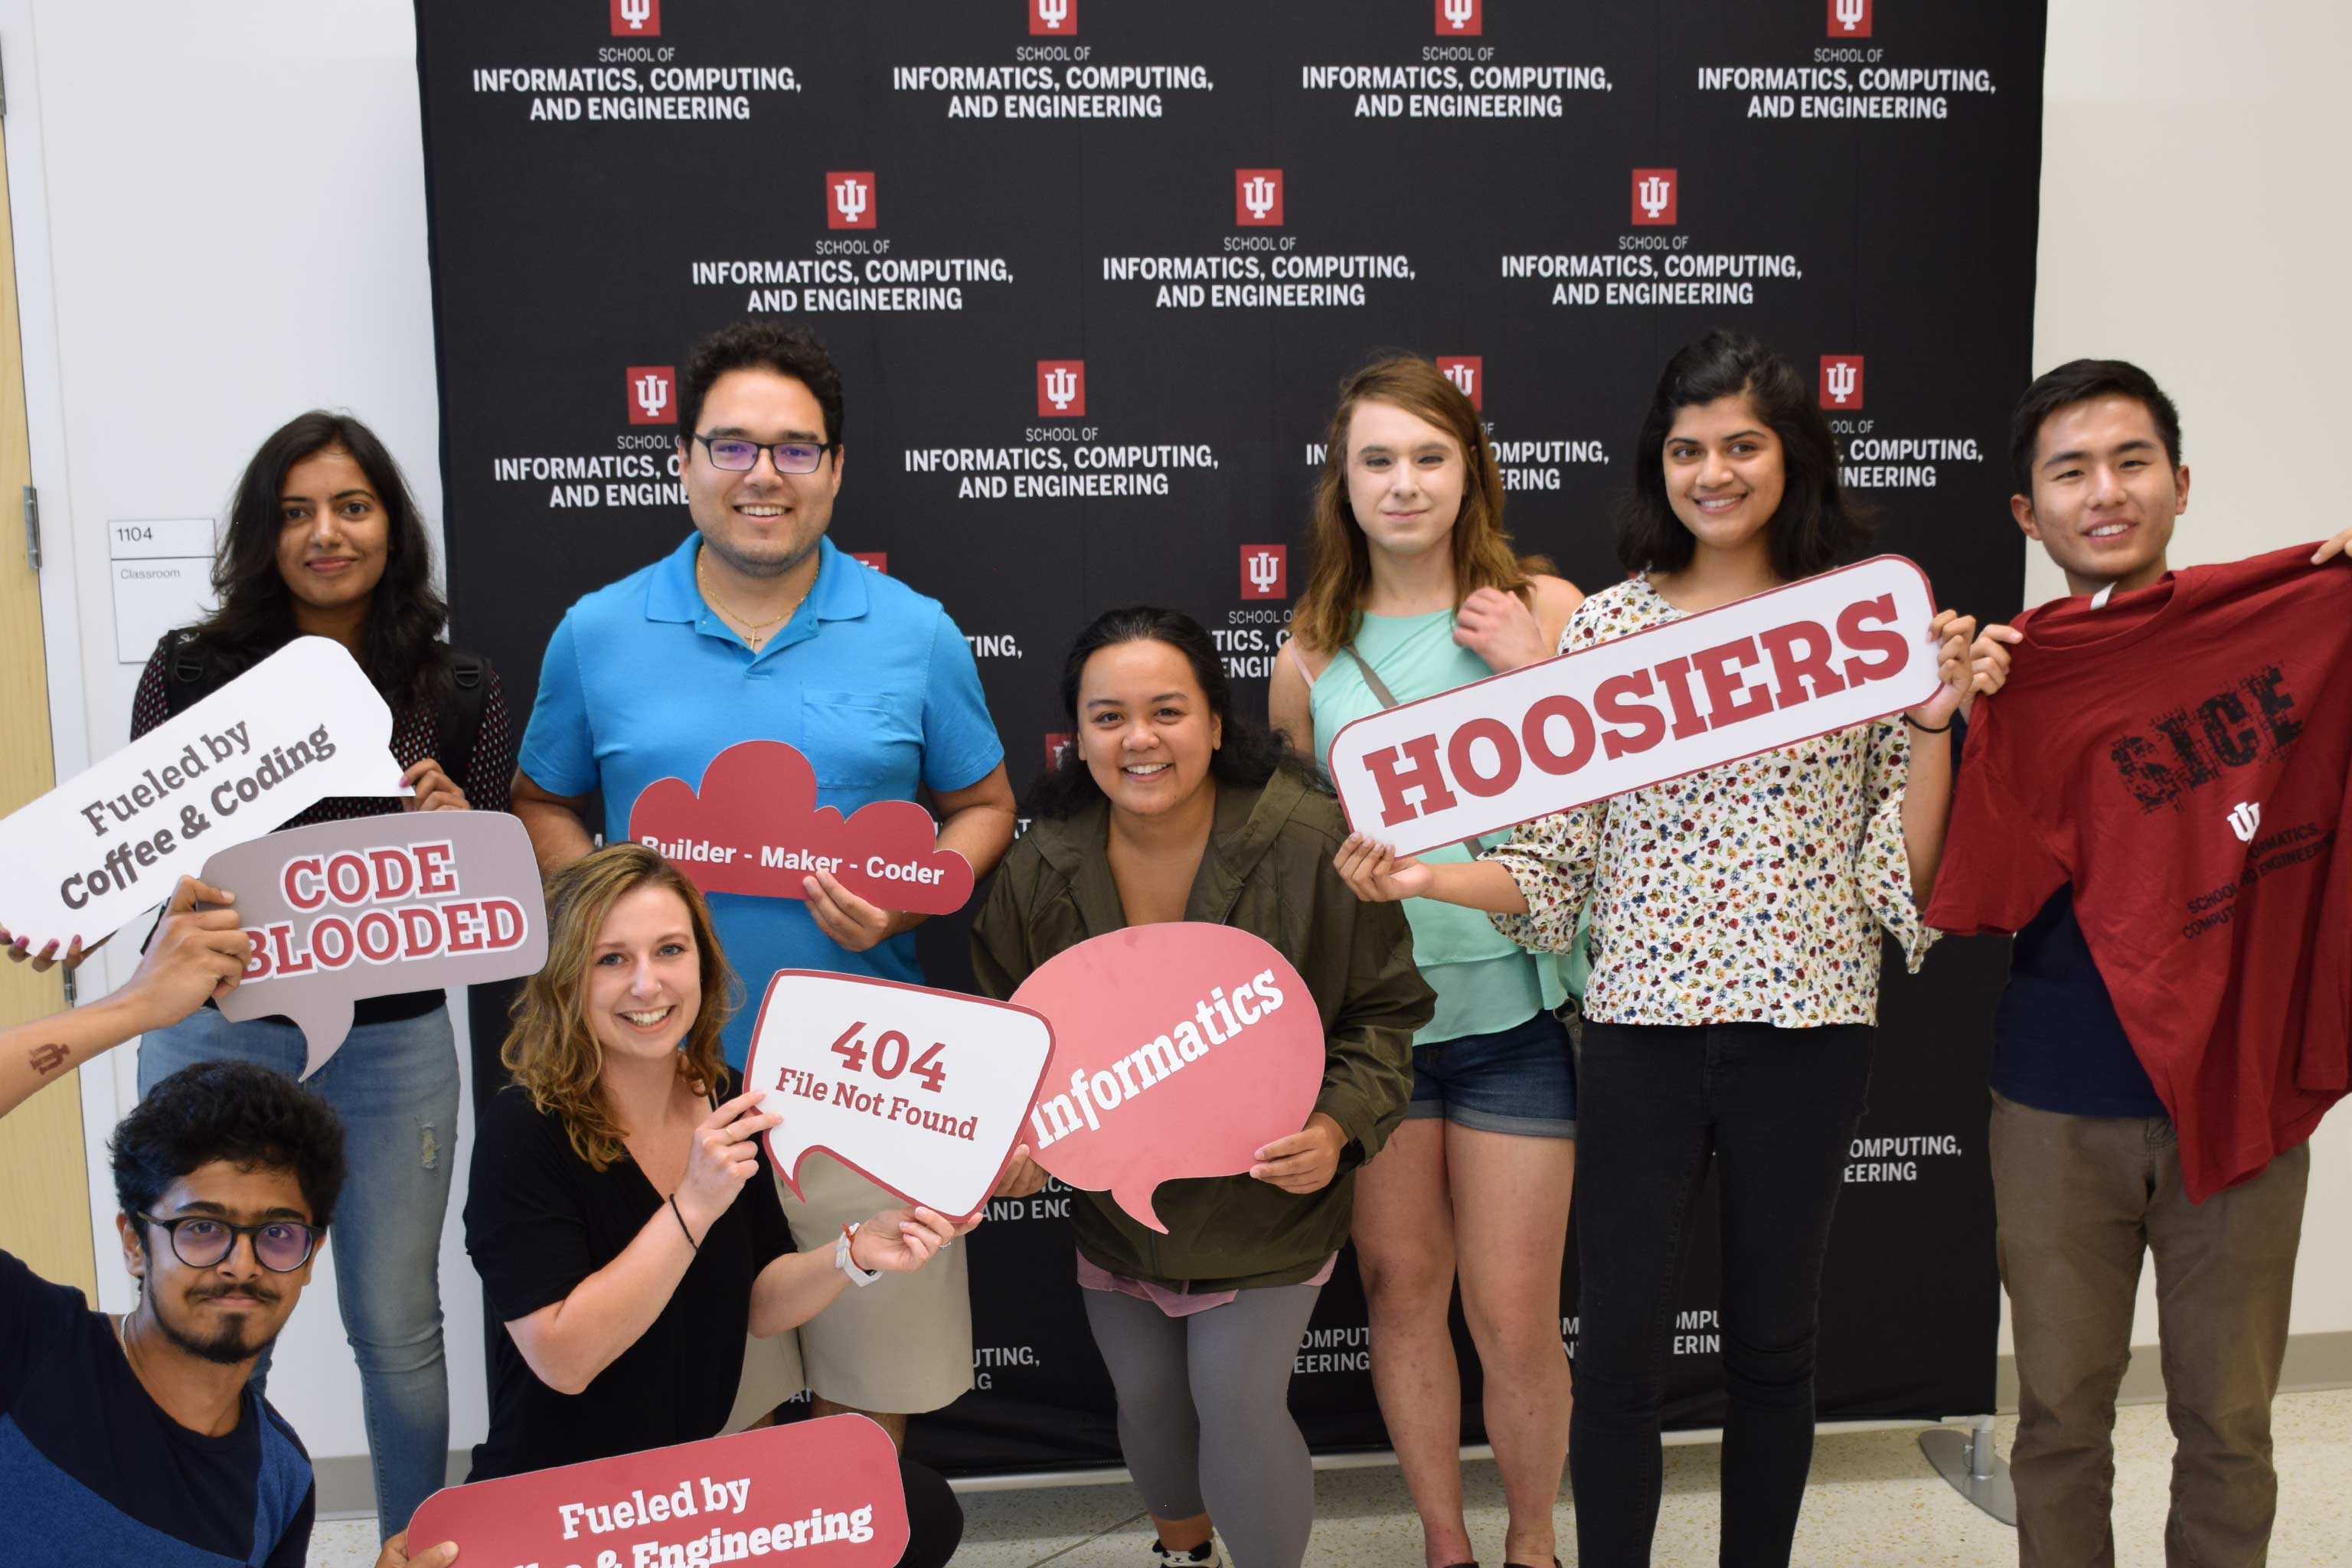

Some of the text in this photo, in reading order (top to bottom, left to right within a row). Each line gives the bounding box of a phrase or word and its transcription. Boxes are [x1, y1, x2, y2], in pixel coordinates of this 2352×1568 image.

[599, 47, 675, 63] SCHOOL OF
[1016, 46, 1091, 62] SCHOOL OF
[1423, 46, 1495, 61] SCHOOL OF
[1814, 47, 1883, 63] SCHOOL OF
[473, 67, 802, 93] INFORMATICS, COMPUTING,
[893, 65, 1214, 93] INFORMATICS, COMPUTING,
[1302, 66, 1612, 92] INFORMATICS, COMPUTING,
[1698, 67, 1996, 94] INFORMATICS, COMPUTING,
[530, 96, 750, 121] AND ENGINEERING
[948, 94, 1162, 119] AND ENGINEERING
[1354, 94, 1563, 117] AND ENGINEERING
[1747, 95, 1947, 119] AND ENGINEERING
[815, 239, 890, 255] SCHOOL OF
[1223, 237, 1297, 252] SCHOOL OF
[1619, 236, 1689, 250] SCHOOL OF
[692, 258, 1014, 286] INFORMATICS, COMPUTING,
[1103, 255, 1416, 281] INFORMATICS, COMPUTING,
[1501, 254, 1802, 279] INFORMATICS, COMPUTING,
[747, 287, 962, 312] AND ENGINEERING
[1155, 283, 1365, 308] AND ENGINEERING
[1552, 282, 1753, 305] AND ENGINEERING
[1025, 426, 1099, 443] SCHOOL OF
[1857, 420, 1874, 433] OF
[617, 435, 671, 449] SCHOOL
[1489, 440, 1609, 465] OMPUTING,
[1850, 439, 1983, 462] COMPUTING,
[494, 455, 662, 481] INFORMATICS,
[905, 444, 1219, 472] INFORMATICS, COMPUTING,
[550, 481, 690, 508] AND ENGINE
[958, 472, 1169, 498] AND ENGINEERING
[117, 527, 153, 542] 1104
[120, 569, 181, 580] Classroom
[1228, 610, 1281, 625] SCHOOL
[1363, 592, 1909, 827] HOOSIERS
[81, 719, 252, 838] Fueled by
[60, 723, 337, 911] Coffee & Coding
[284, 843, 458, 910] CODE
[761, 845, 843, 874] Maker
[866, 856, 945, 885] Coder
[2181, 905, 2235, 939] COMPUT
[243, 900, 526, 982] BLOODED
[831, 1021, 947, 1093] 404
[1031, 968, 1285, 1150] Informatics
[776, 1067, 978, 1142] File Not Found
[1849, 1135, 1962, 1158] OMPUTING,
[1843, 1161, 1918, 1183] EERING
[1293, 1351, 1370, 1374] EERING
[559, 1476, 751, 1540] Fueled by
[632, 1504, 874, 1568] Engineering
